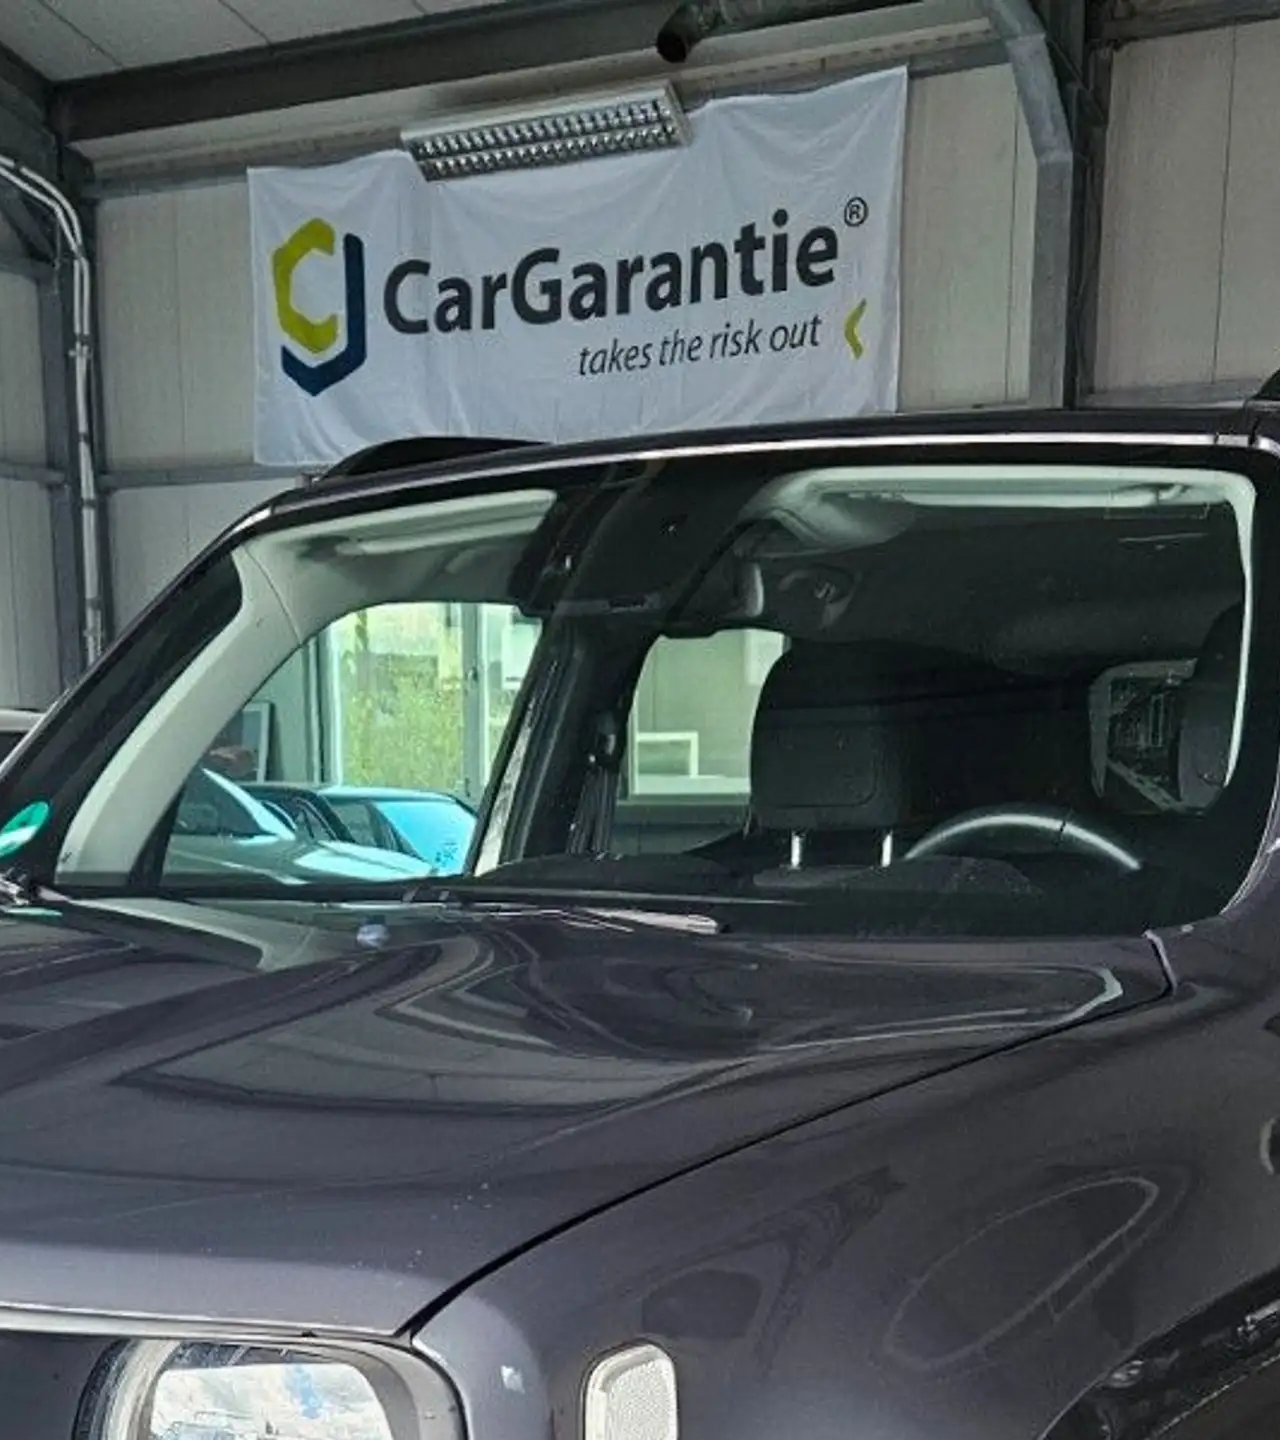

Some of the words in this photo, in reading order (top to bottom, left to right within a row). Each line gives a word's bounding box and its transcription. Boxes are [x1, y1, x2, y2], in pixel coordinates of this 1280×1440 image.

[578, 338, 652, 377] takes
[659, 330, 704, 365] the
[709, 322, 761, 359] risk
[769, 314, 822, 349] out
